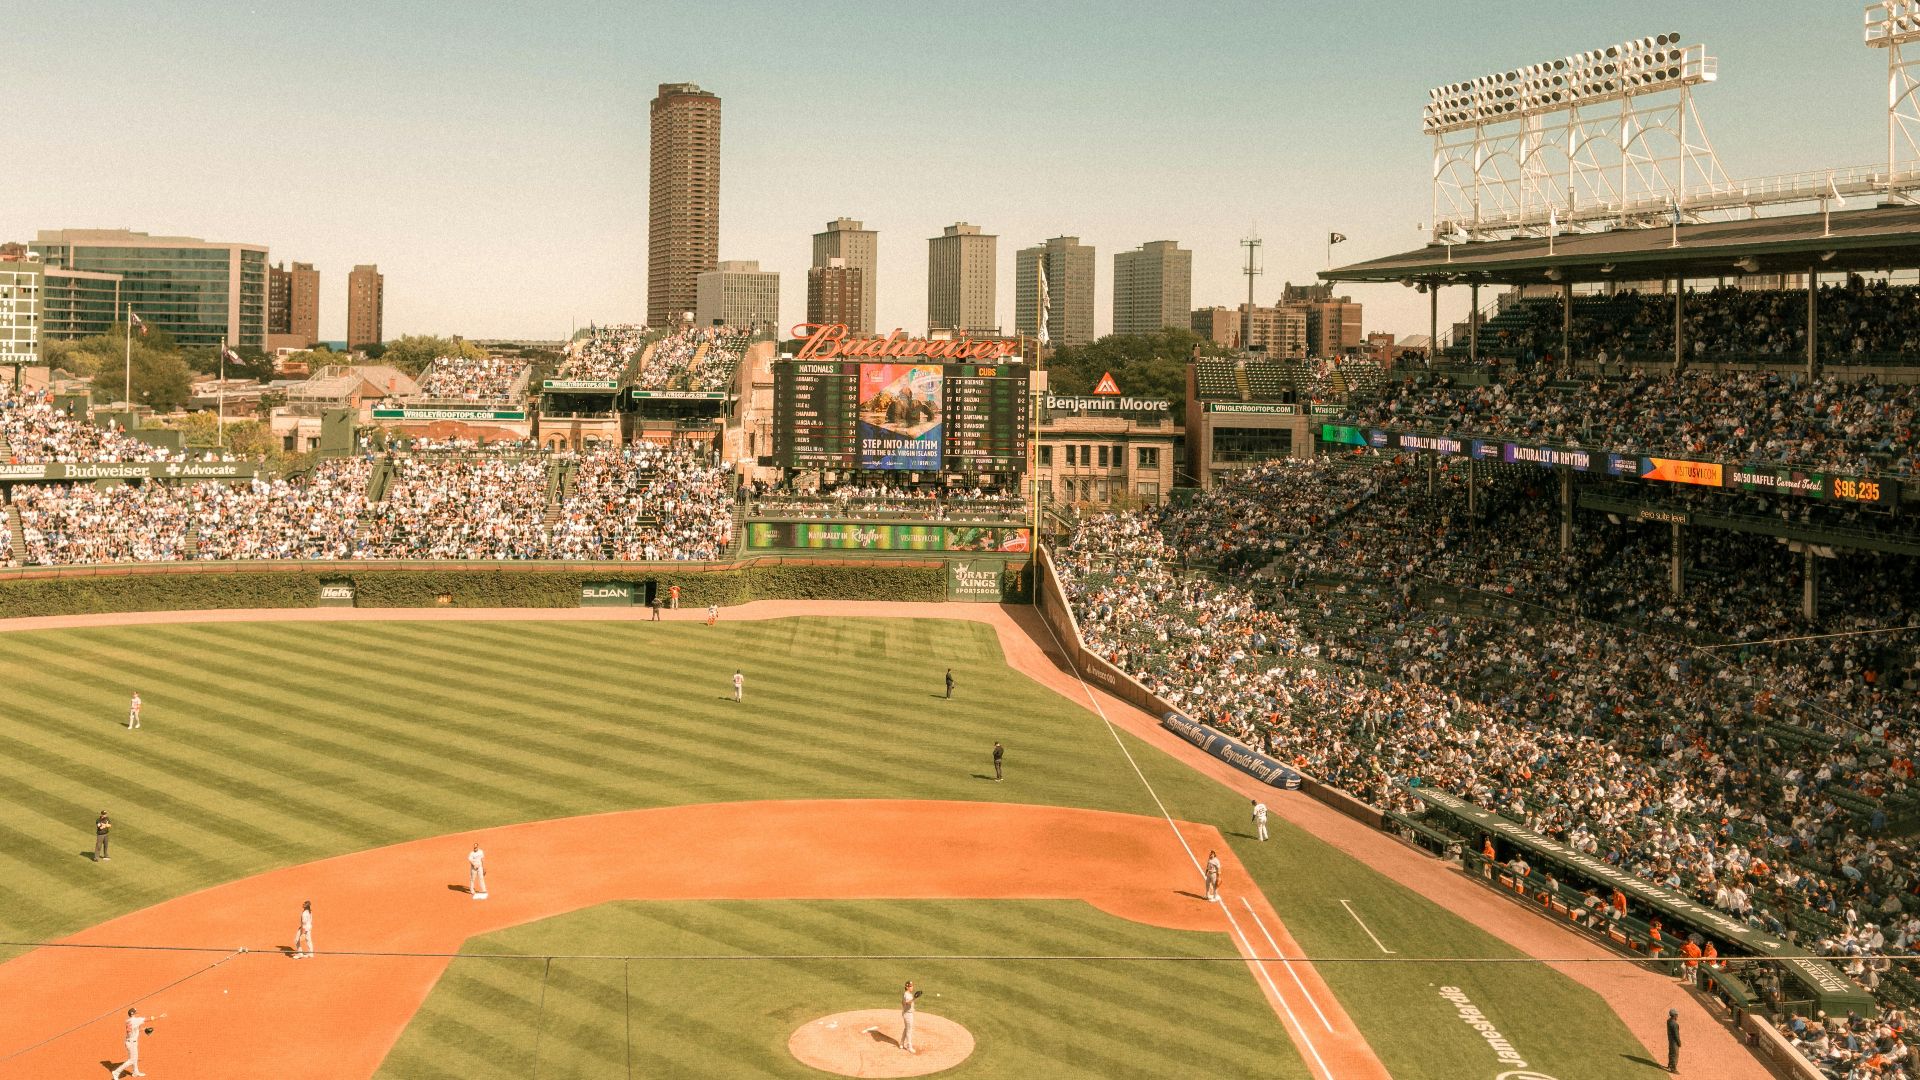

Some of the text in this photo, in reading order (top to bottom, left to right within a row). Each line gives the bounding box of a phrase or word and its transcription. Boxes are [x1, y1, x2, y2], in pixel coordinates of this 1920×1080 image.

[791, 323, 1017, 360] Budweiser
[799, 365, 834, 373] NATIONALS
[979, 368, 996, 376] CUBS
[1046, 396, 1115, 412] Benjamin
[1120, 397, 1168, 410] Moore
[1215, 404, 1291, 413] WRIGLEYROOFTOPS.COM
[862, 439, 938, 449] STEP INTO RHYTHM
[1400, 435, 1430, 449] NATURALLY
[1430, 439, 1436, 450] IN
[1437, 439, 1461, 452] RHYTHM
[1514, 447, 1550, 463] NATURALLY
[1552, 453, 1559, 464] IN
[1560, 453, 1589, 467] RHYTHM
[182, 464, 236, 475] Advocate
[1674, 466, 1717, 479] VISITUSVI.COM
[1733, 472, 1750, 483] 50/50
[1752, 473, 1774, 486] RAFFLE
[1776, 477, 1801, 489] Current
[1834, 478, 1879, 500] $96,235
[1672, 513, 1686, 523] level
[851, 528, 888, 546] Rhythm
[956, 571, 997, 580] DRAFT
[324, 589, 352, 597] Hefty
[1167, 714, 1206, 745] Reynolds Wrap
[1221, 744, 1271, 778] Reynolds Wrap
[1438, 986, 1528, 1068] JamesHardie
